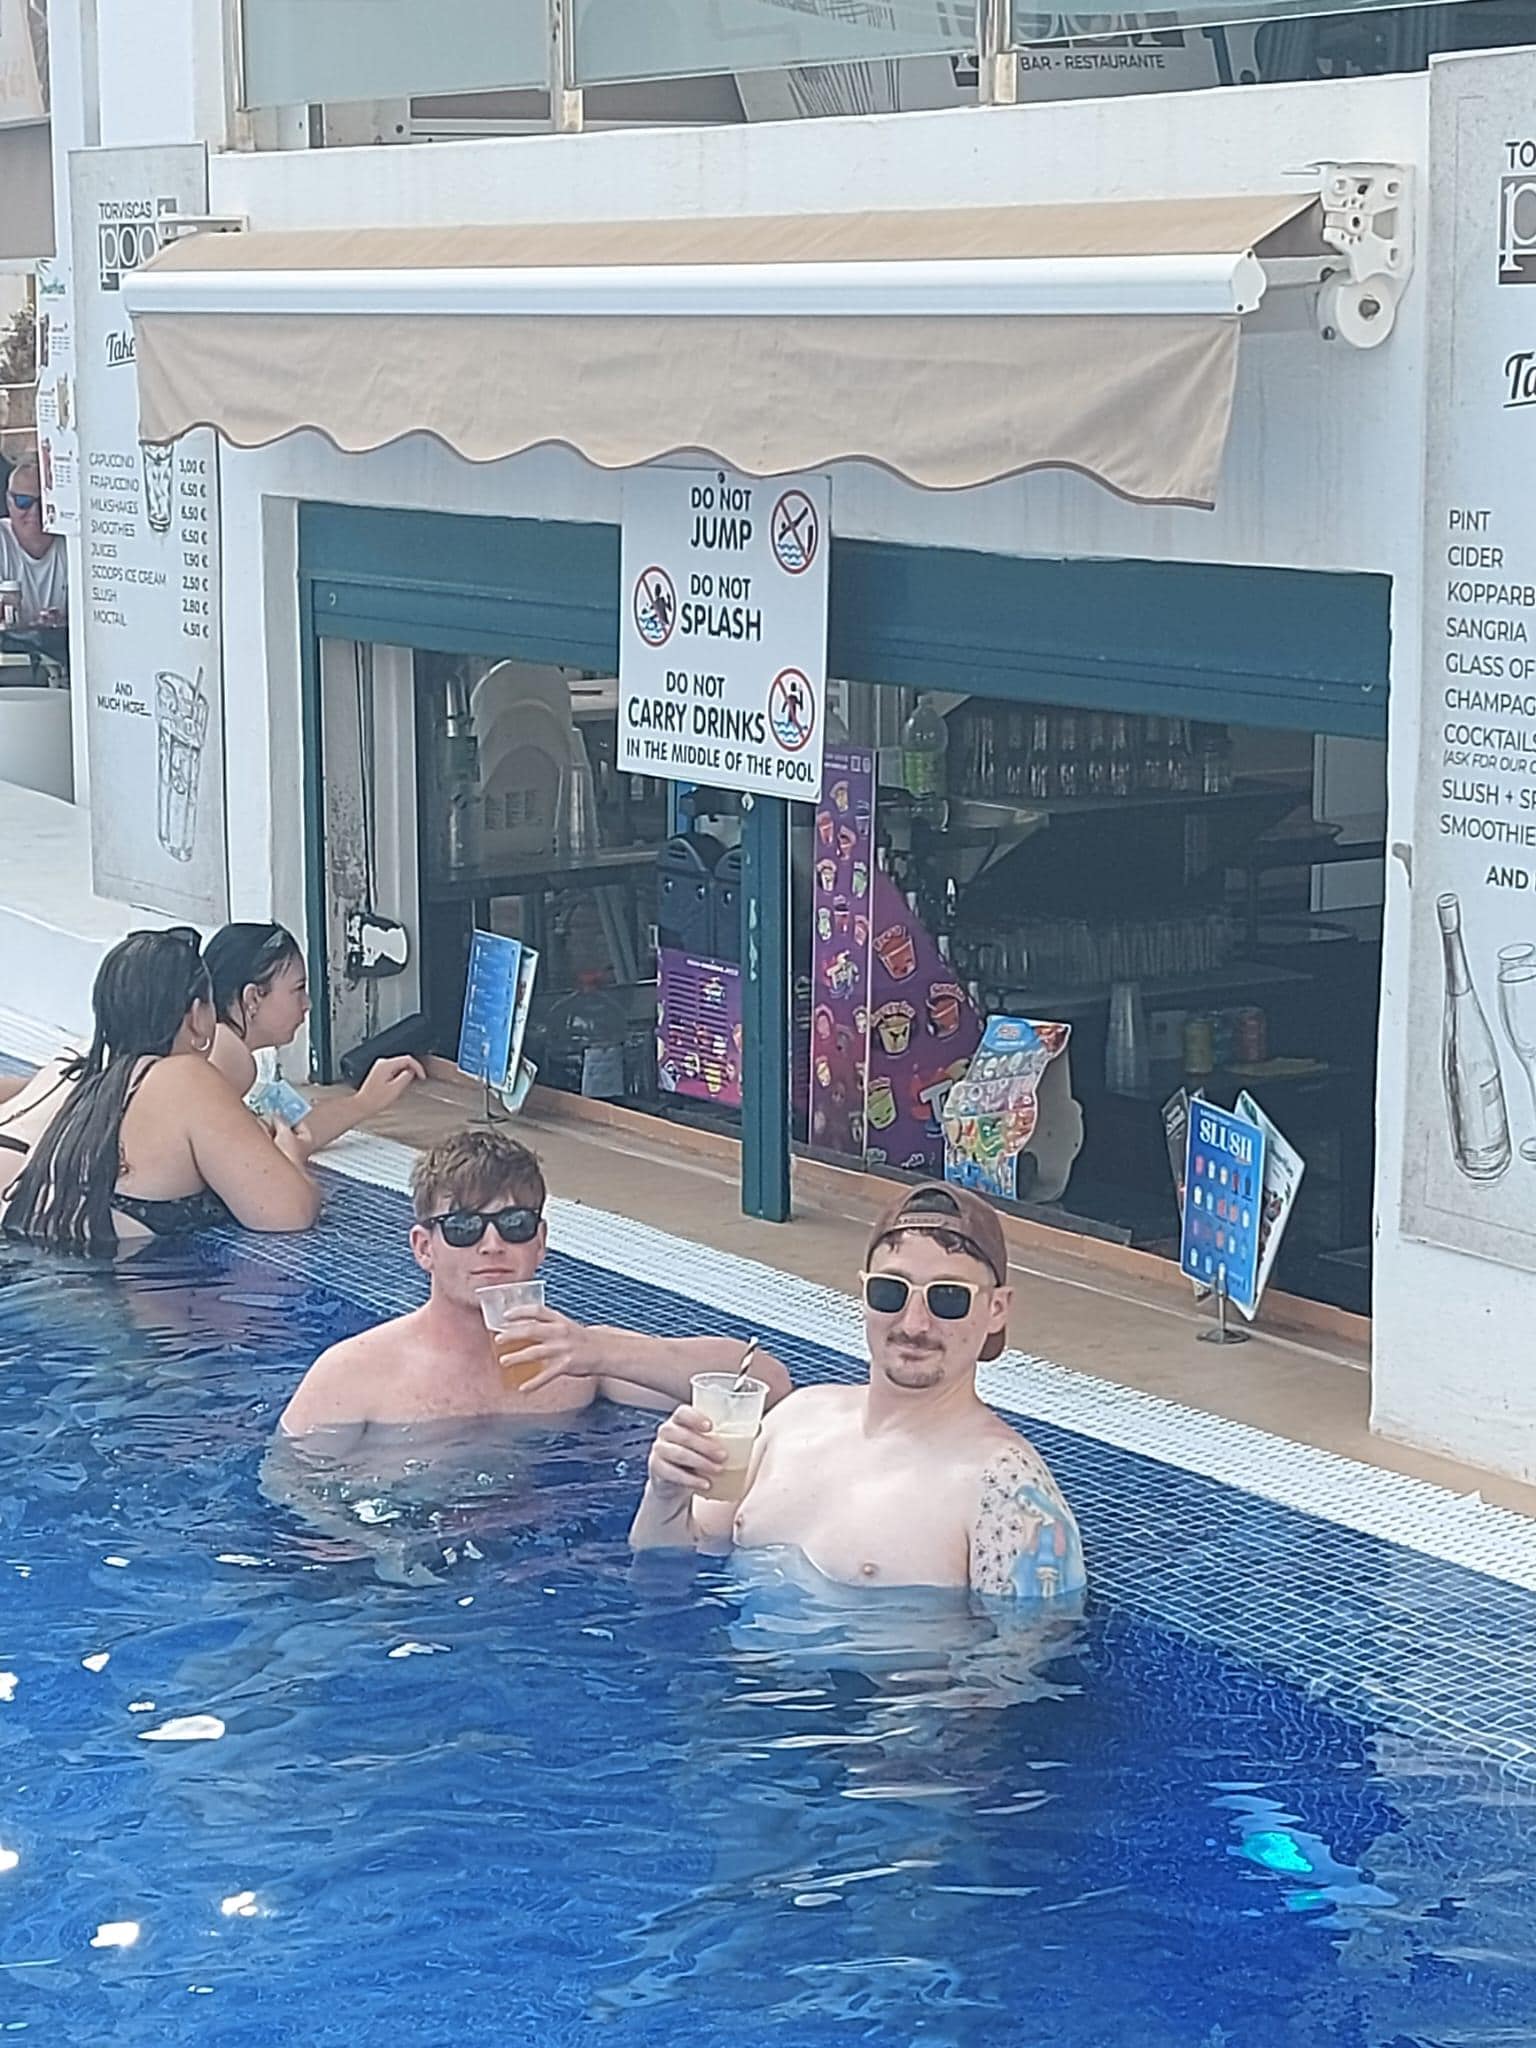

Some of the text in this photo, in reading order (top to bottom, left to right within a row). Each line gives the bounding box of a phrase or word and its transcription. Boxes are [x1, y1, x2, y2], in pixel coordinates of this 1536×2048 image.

[1020, 56, 1052, 71] BAR
[1065, 54, 1167, 70] RESTAURANTE
[98, 200, 152, 220] TORVISCAS
[105, 329, 136, 362] Take
[691, 486, 752, 512] DO NOT
[690, 516, 752, 551] JUMP
[1449, 509, 1492, 532] PINT
[1447, 545, 1504, 569] CIDER
[91, 565, 124, 582] SCOOPS
[138, 570, 167, 586] CREAM
[691, 573, 751, 600] DO NOT
[1447, 581, 1536, 607] KOPPARB
[680, 603, 762, 642] SPLASH
[1445, 616, 1528, 643] SANGRIA
[1445, 652, 1536, 680] GLASS OF
[115, 681, 133, 697] AND
[666, 670, 725, 699] DO NOT
[97, 695, 121, 713] MUCH
[1444, 688, 1536, 717] CHAMPAG
[628, 697, 767, 745] CARRY DRINKS
[626, 738, 641, 758] IN
[644, 739, 668, 761] THE
[671, 744, 721, 769] MIDDLE
[725, 751, 743, 773] OF
[747, 754, 773, 777] THE
[776, 758, 815, 784] POOL
[1472, 752, 1497, 769] FOR
[1500, 756, 1528, 774] OUR
[1442, 779, 1499, 806] SLUSH
[1440, 813, 1536, 847] SMOOTHIE
[1486, 865, 1529, 890] AND
[1200, 1118, 1253, 1164] SLUSH
